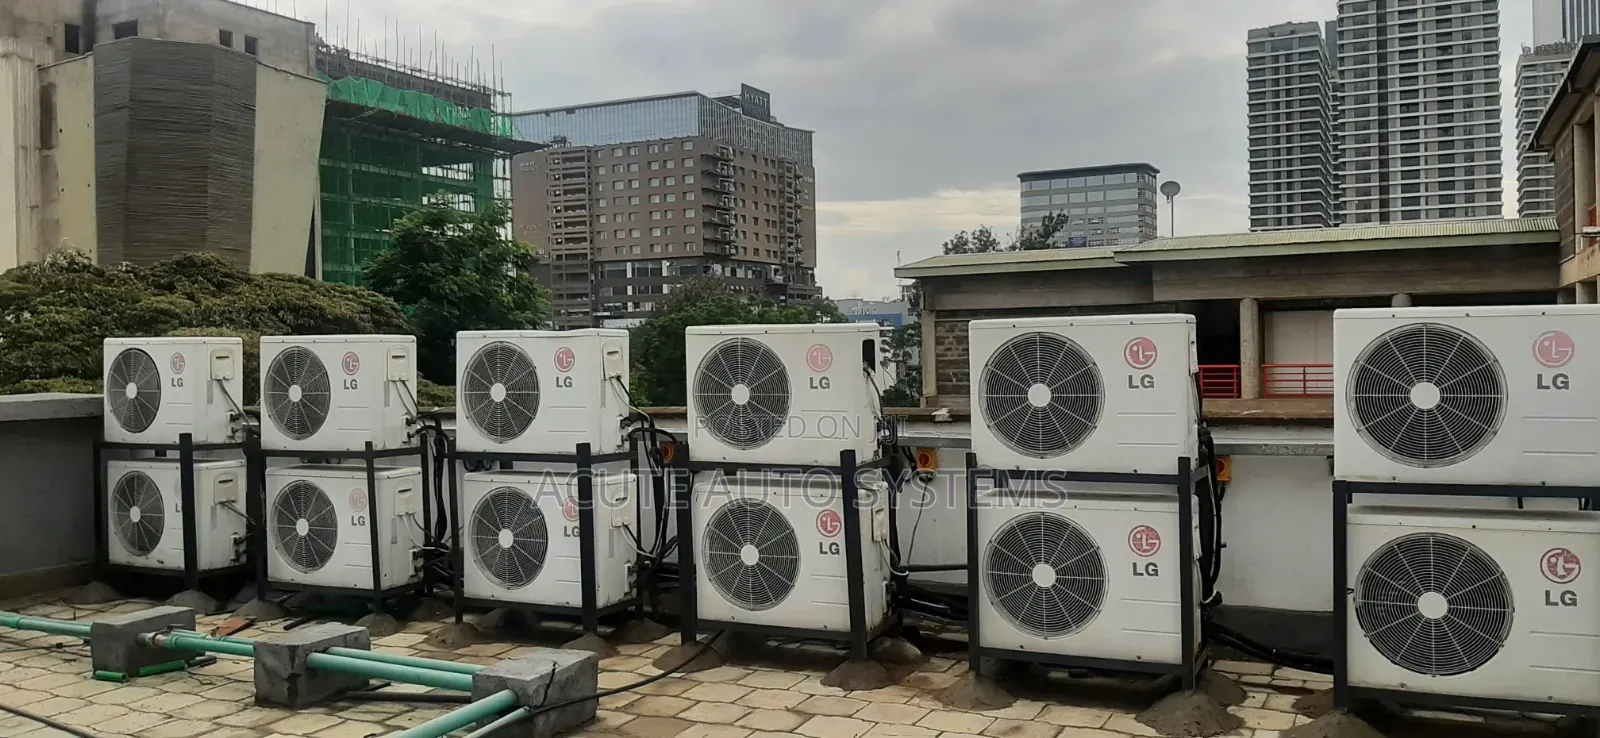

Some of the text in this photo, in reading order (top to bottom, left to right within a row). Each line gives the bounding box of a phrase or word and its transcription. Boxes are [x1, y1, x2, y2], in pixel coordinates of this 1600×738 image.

[744, 91, 768, 108] HYATT
[172, 378, 184, 388] LG
[344, 378, 358, 390] LG
[556, 376, 573, 388] LG
[810, 377, 830, 390] LG
[1128, 375, 1155, 389] LG
[1537, 374, 1570, 390] LG
[351, 515, 366, 526] LG
[563, 525, 580, 538] LG
[820, 541, 840, 556] LG
[1132, 561, 1159, 577] LG
[1545, 589, 1578, 607] LG
